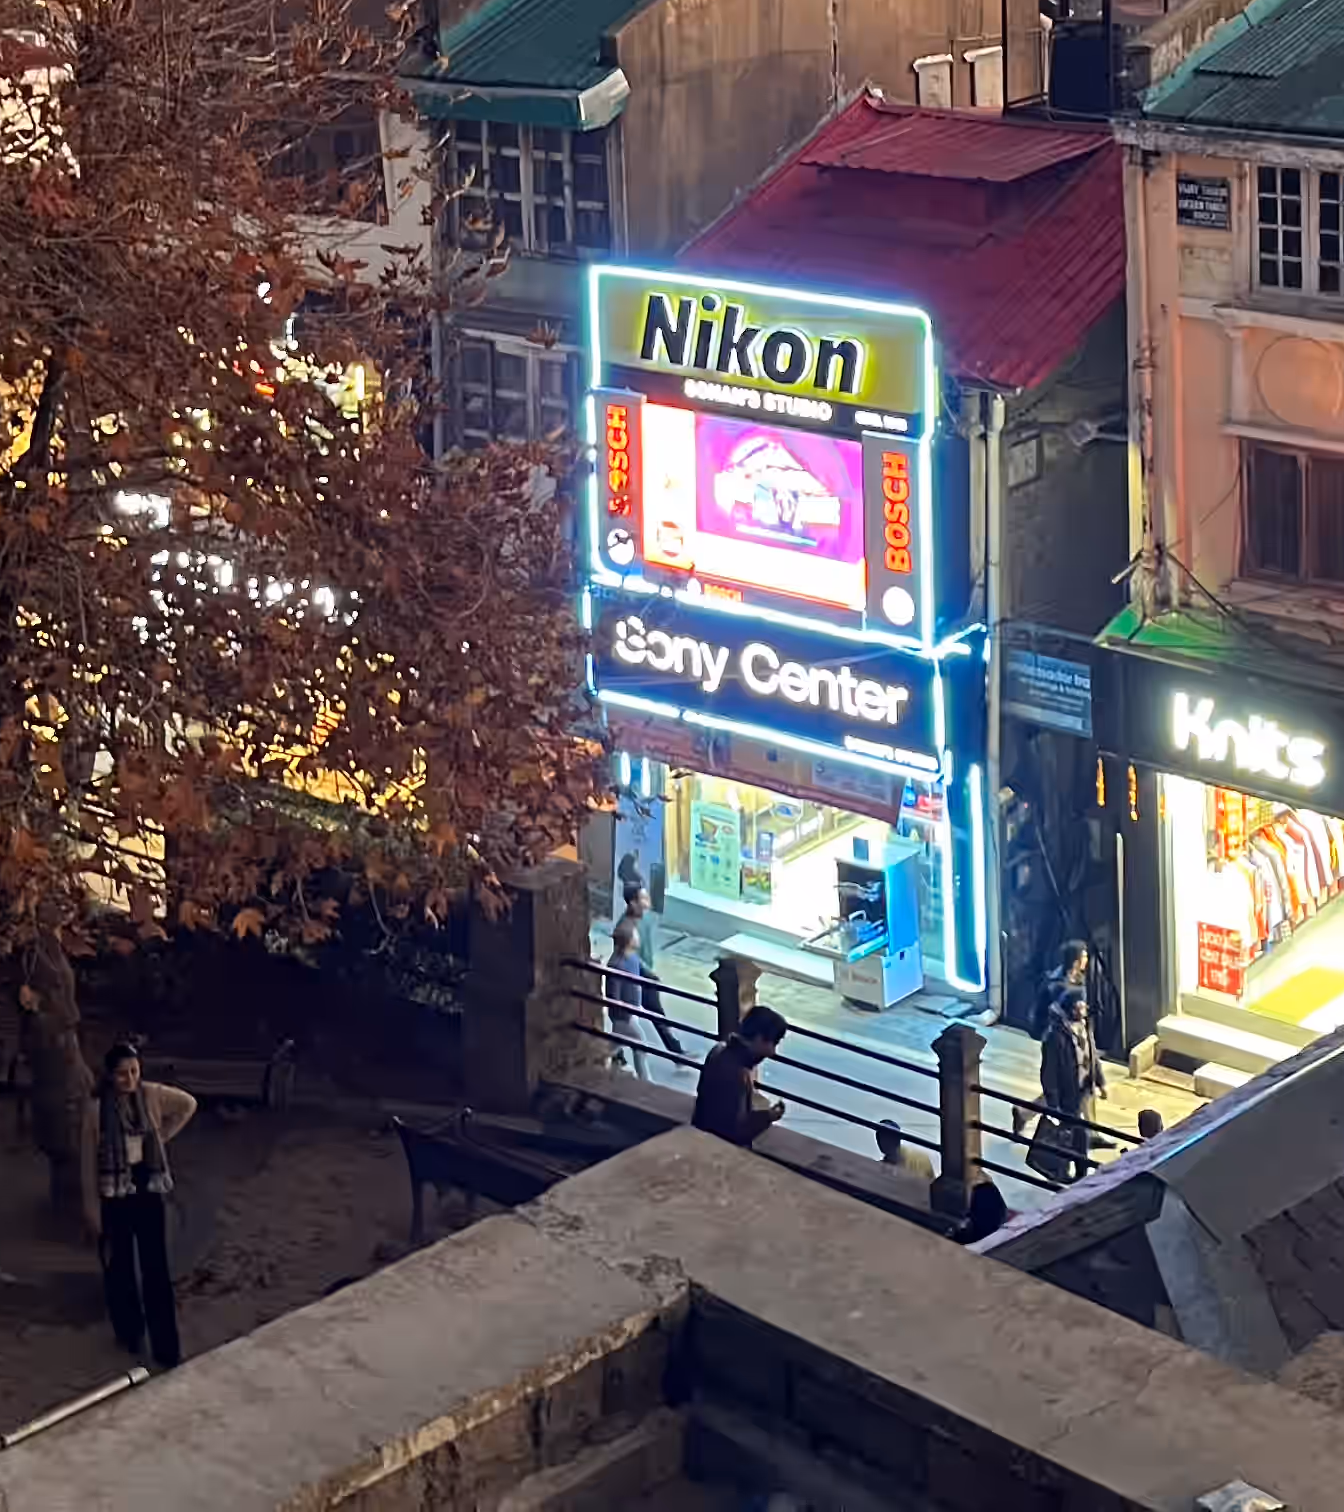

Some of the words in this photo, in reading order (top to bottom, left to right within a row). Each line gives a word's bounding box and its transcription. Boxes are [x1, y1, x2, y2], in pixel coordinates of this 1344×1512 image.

[640, 292, 865, 396] Nikon
[881, 451, 912, 574] BOSCH
[614, 615, 729, 693] Sony
[740, 640, 908, 725] Center
[1172, 691, 1326, 787] Knits
